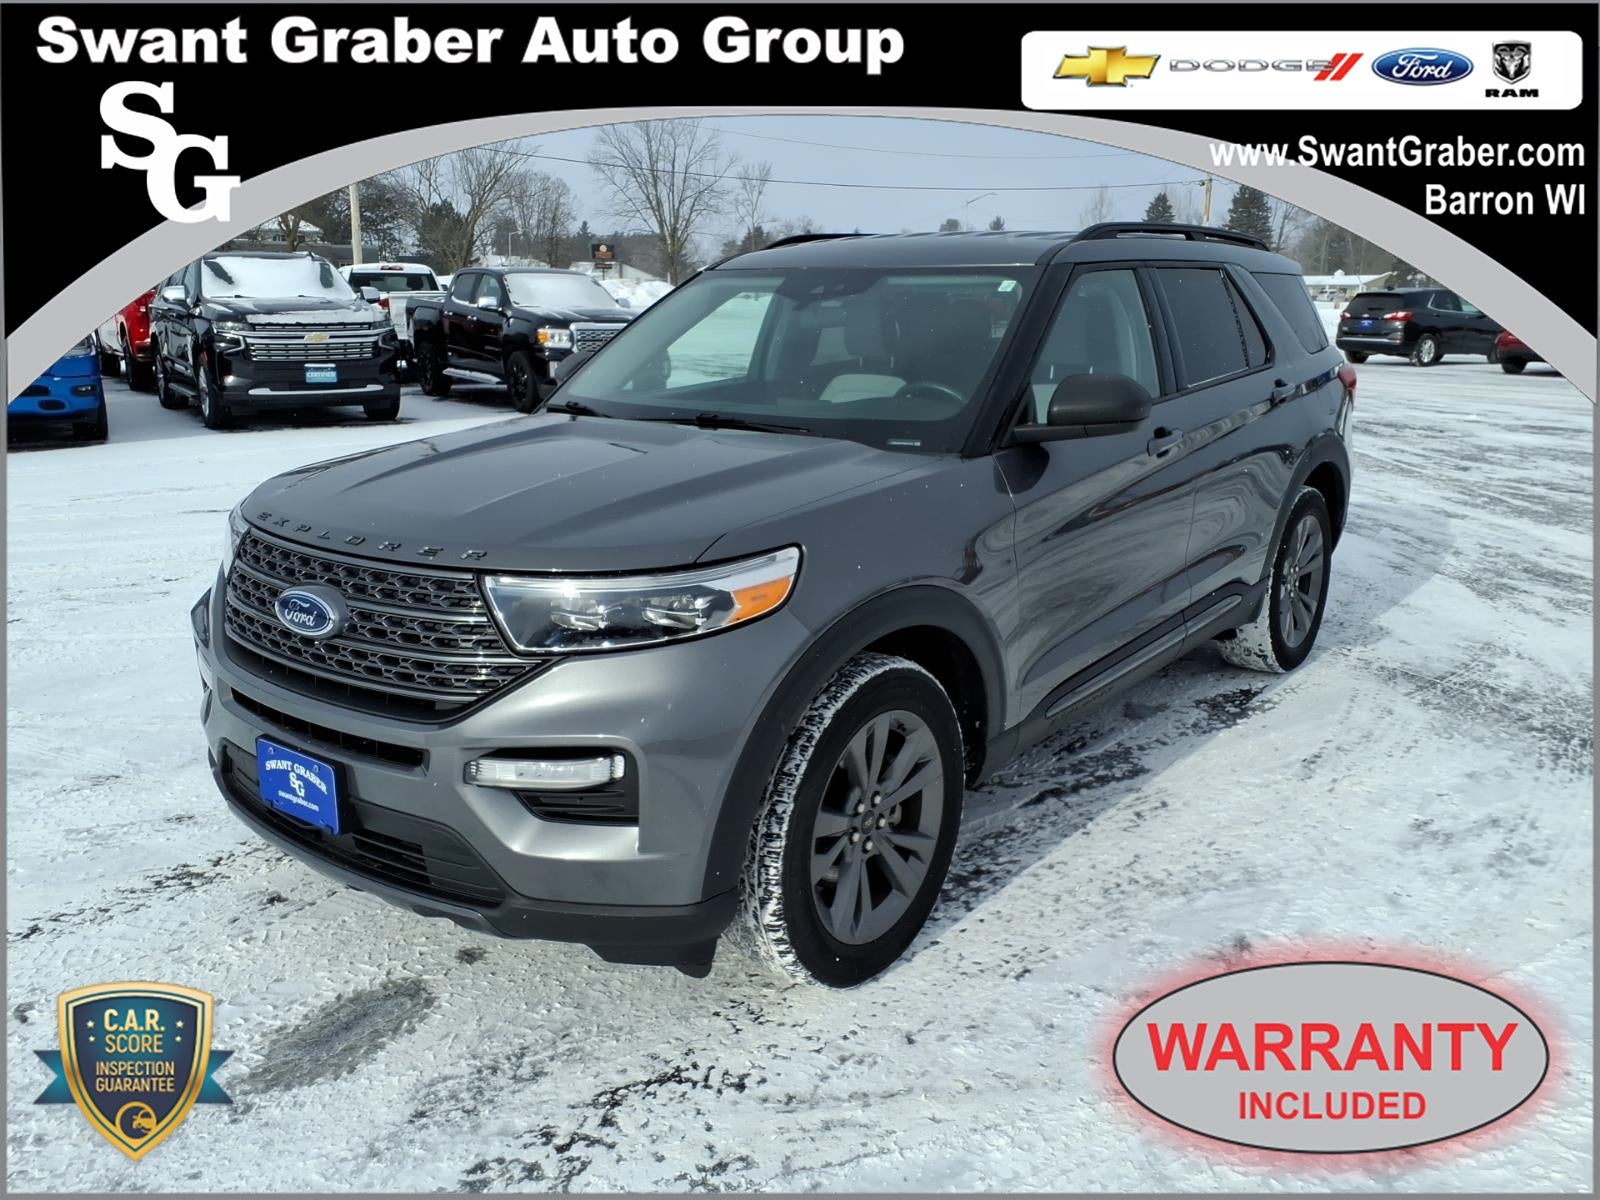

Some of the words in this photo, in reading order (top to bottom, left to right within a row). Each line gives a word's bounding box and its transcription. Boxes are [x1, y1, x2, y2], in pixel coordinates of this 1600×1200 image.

[256, 511, 488, 560] EXPLORER
[284, 598, 318, 627] Ford
[265, 760, 293, 771] SWANT
[293, 763, 328, 795] GRABER
